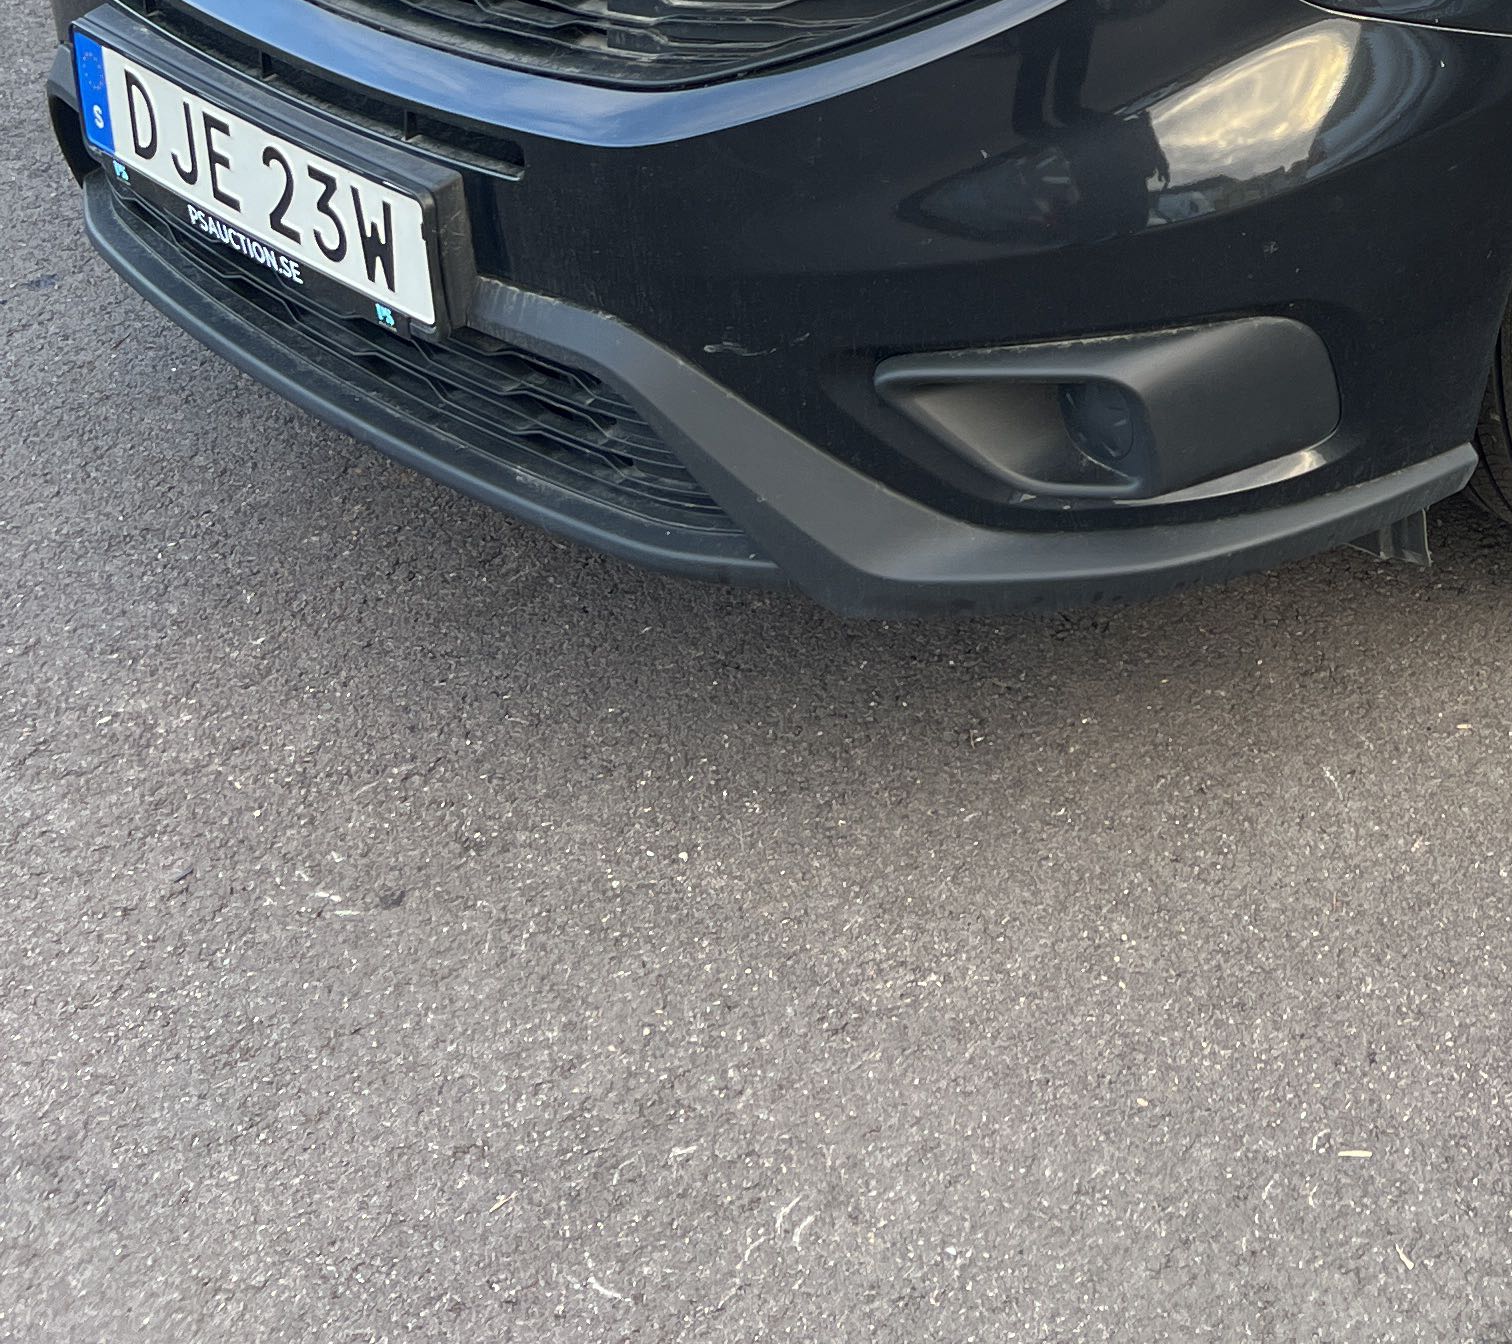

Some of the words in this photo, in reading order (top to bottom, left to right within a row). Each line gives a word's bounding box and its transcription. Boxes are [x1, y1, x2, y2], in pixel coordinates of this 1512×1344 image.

[92, 104, 104, 130] S
[124, 69, 241, 212] DJE
[262, 145, 397, 293] 23W
[187, 204, 304, 285] PSAUCTION.SE
